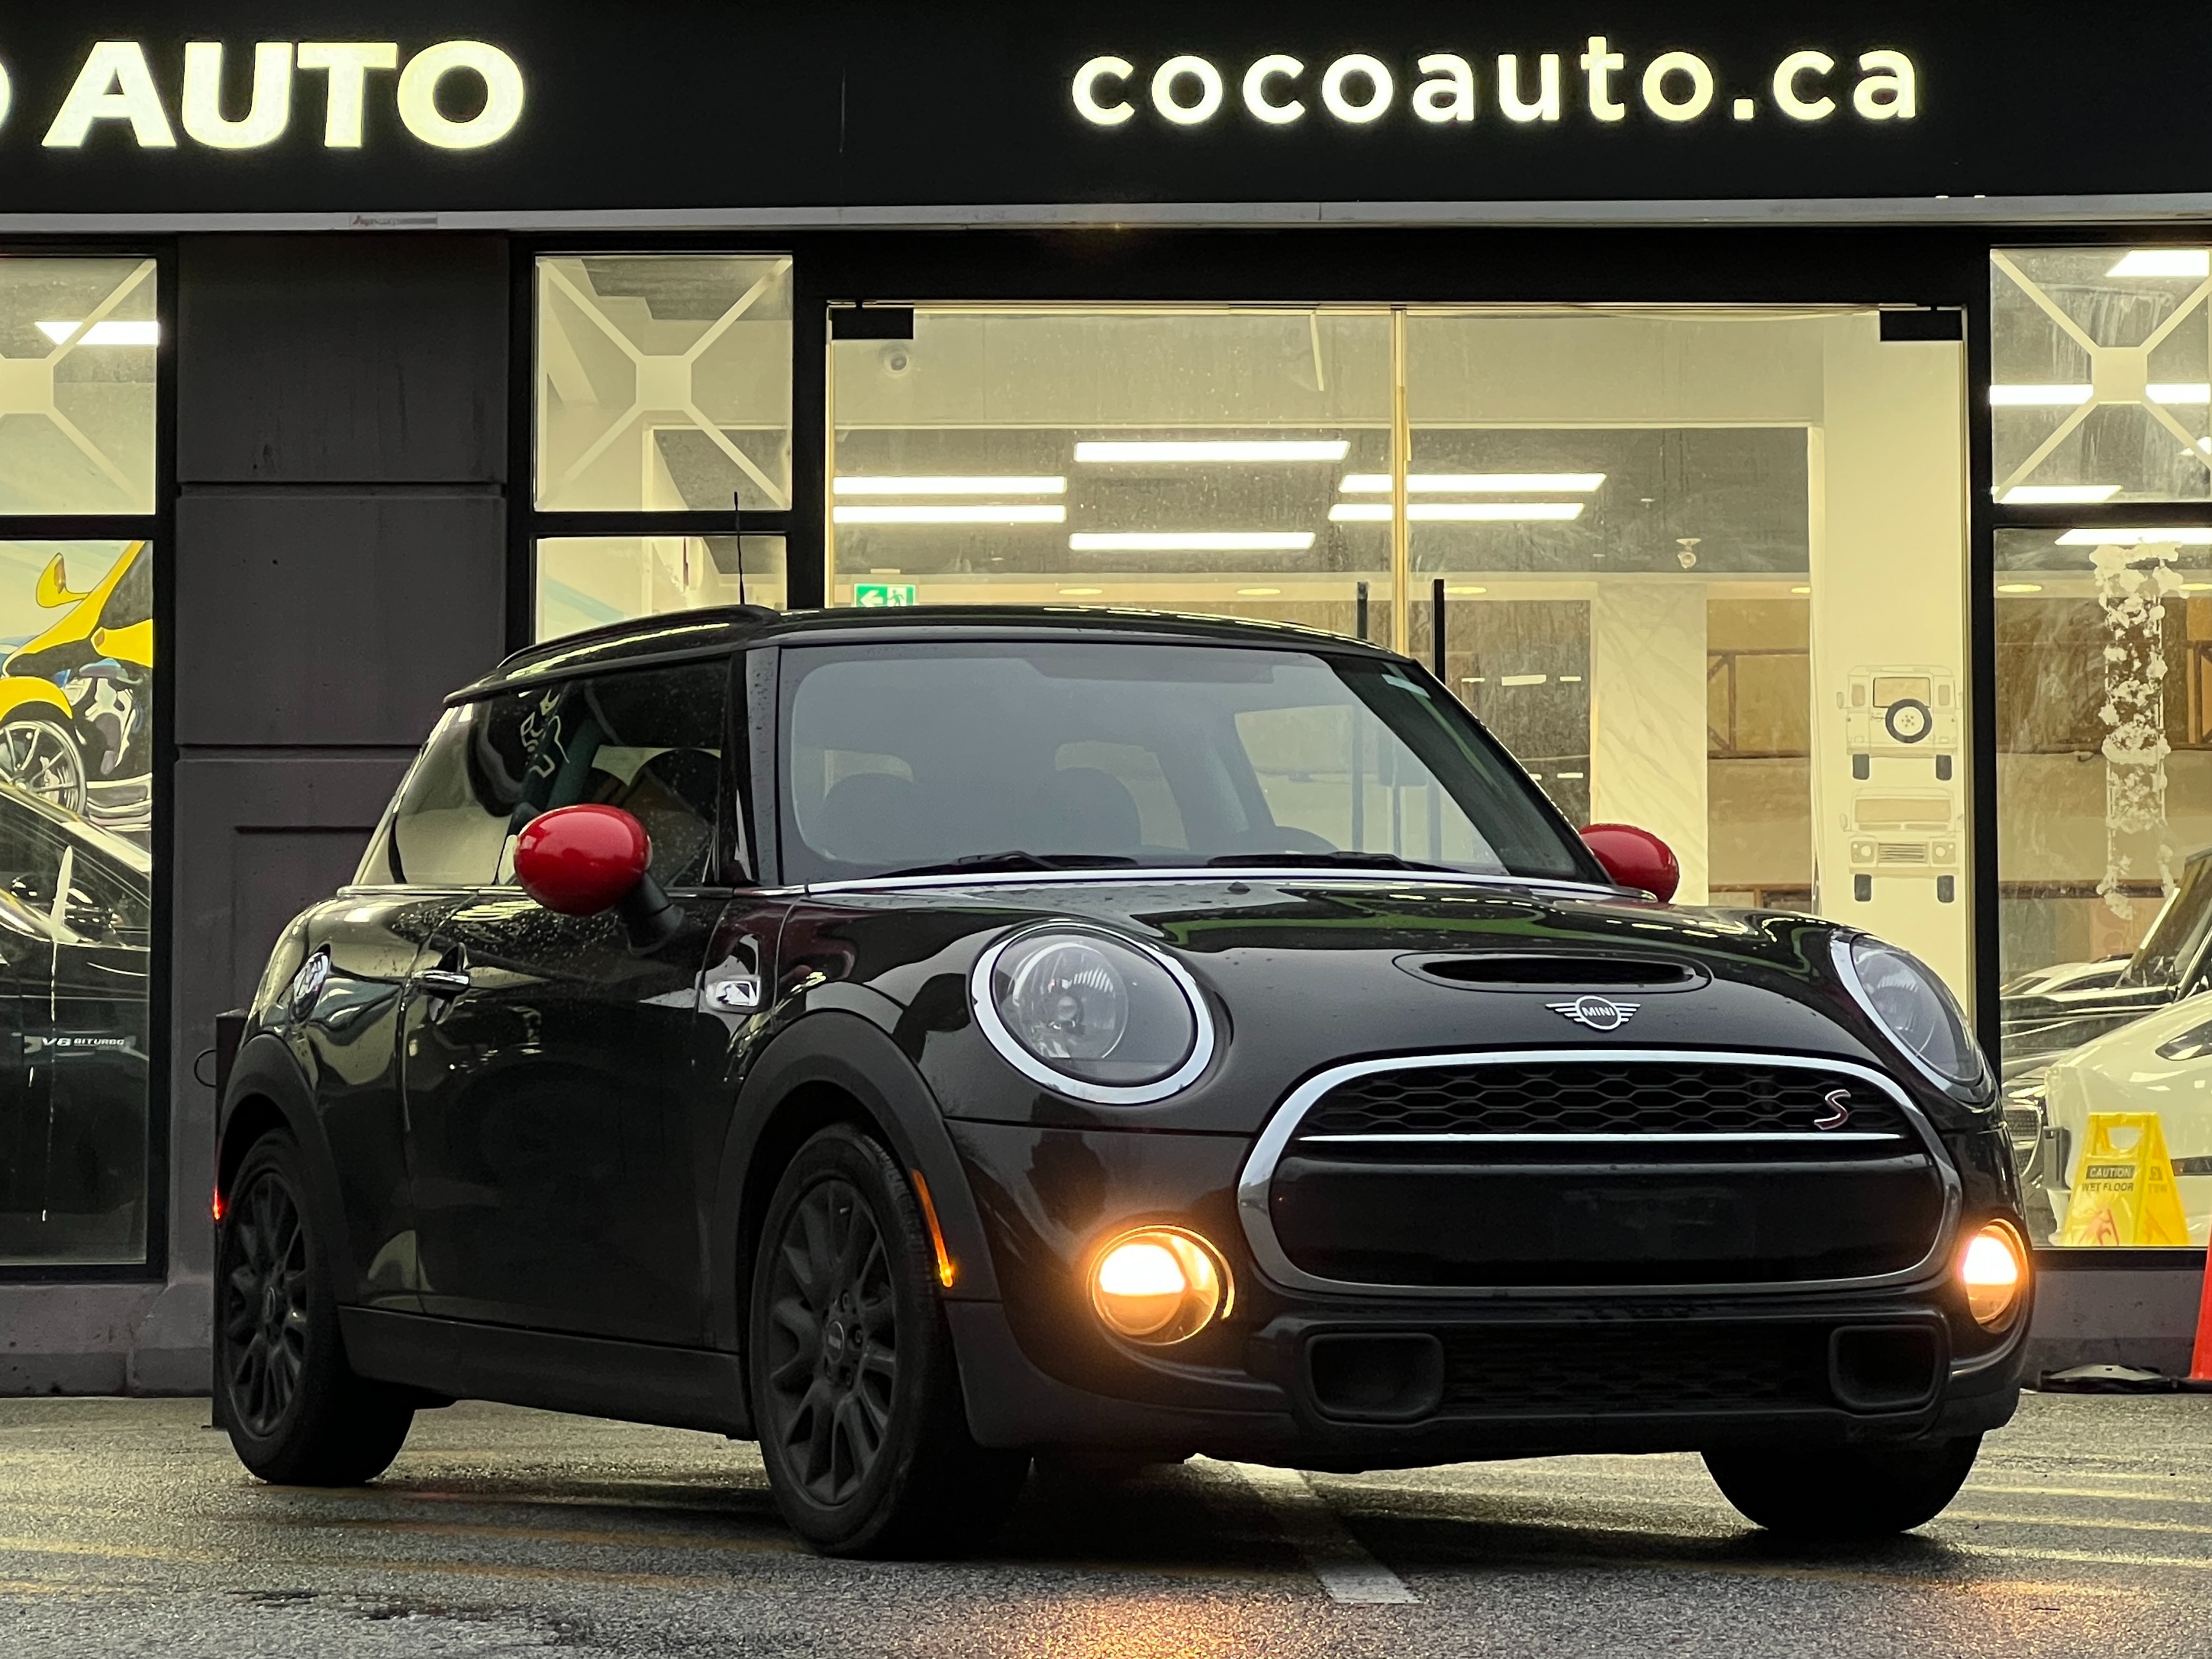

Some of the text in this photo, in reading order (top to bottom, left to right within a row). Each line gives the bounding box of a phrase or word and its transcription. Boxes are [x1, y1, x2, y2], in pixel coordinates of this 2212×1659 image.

[1072, 37, 1915, 126] cocoauto.ca
[41, 40, 525, 150] AUTO
[1581, 1007, 1616, 1016] MINI
[42, 1037, 72, 1046] V8
[1814, 1088, 1852, 1131] S
[2089, 1167, 2133, 1178] CAUTION
[2081, 1182, 2135, 1192] WET FLOOR
